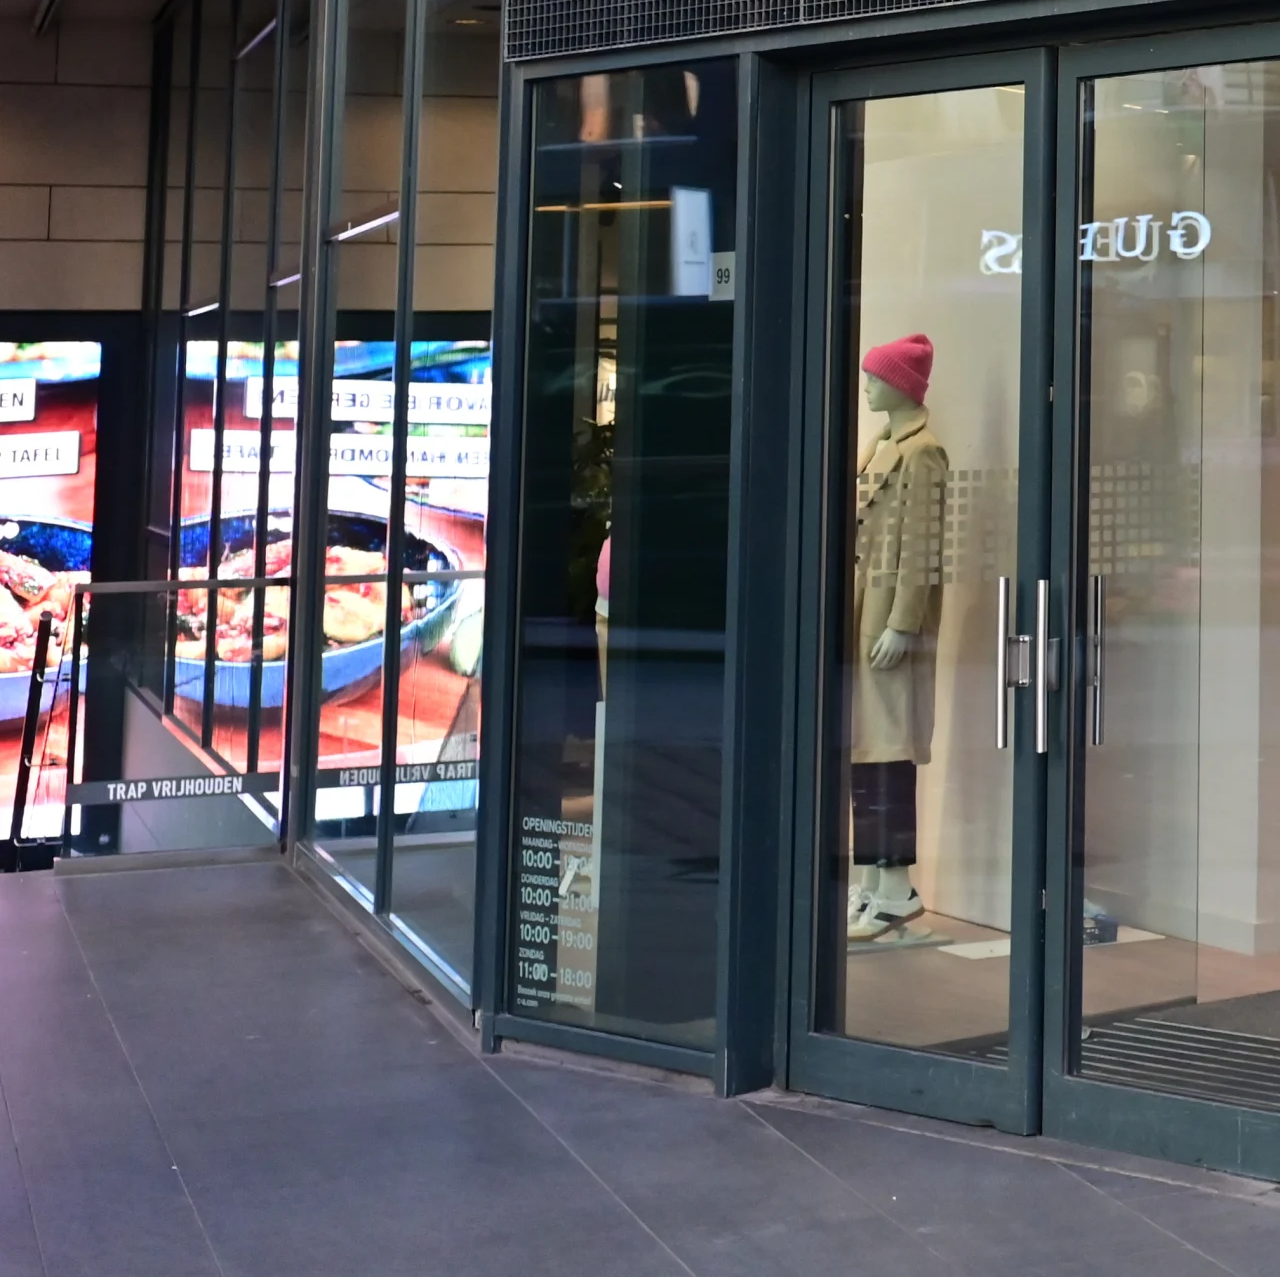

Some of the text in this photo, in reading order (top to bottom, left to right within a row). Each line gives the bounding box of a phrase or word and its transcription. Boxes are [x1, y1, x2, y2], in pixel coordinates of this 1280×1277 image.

[716, 268, 730, 284] 99
[11, 446, 63, 464] TAFEL
[107, 776, 243, 801] TRAP VRIJHOUDEN
[521, 849, 552, 870] 10:00
[520, 886, 551, 907] 10:00
[519, 923, 550, 944] 10:00
[560, 929, 593, 950] 19:00
[518, 960, 549, 982] 11:00
[559, 967, 592, 989] 18:00
